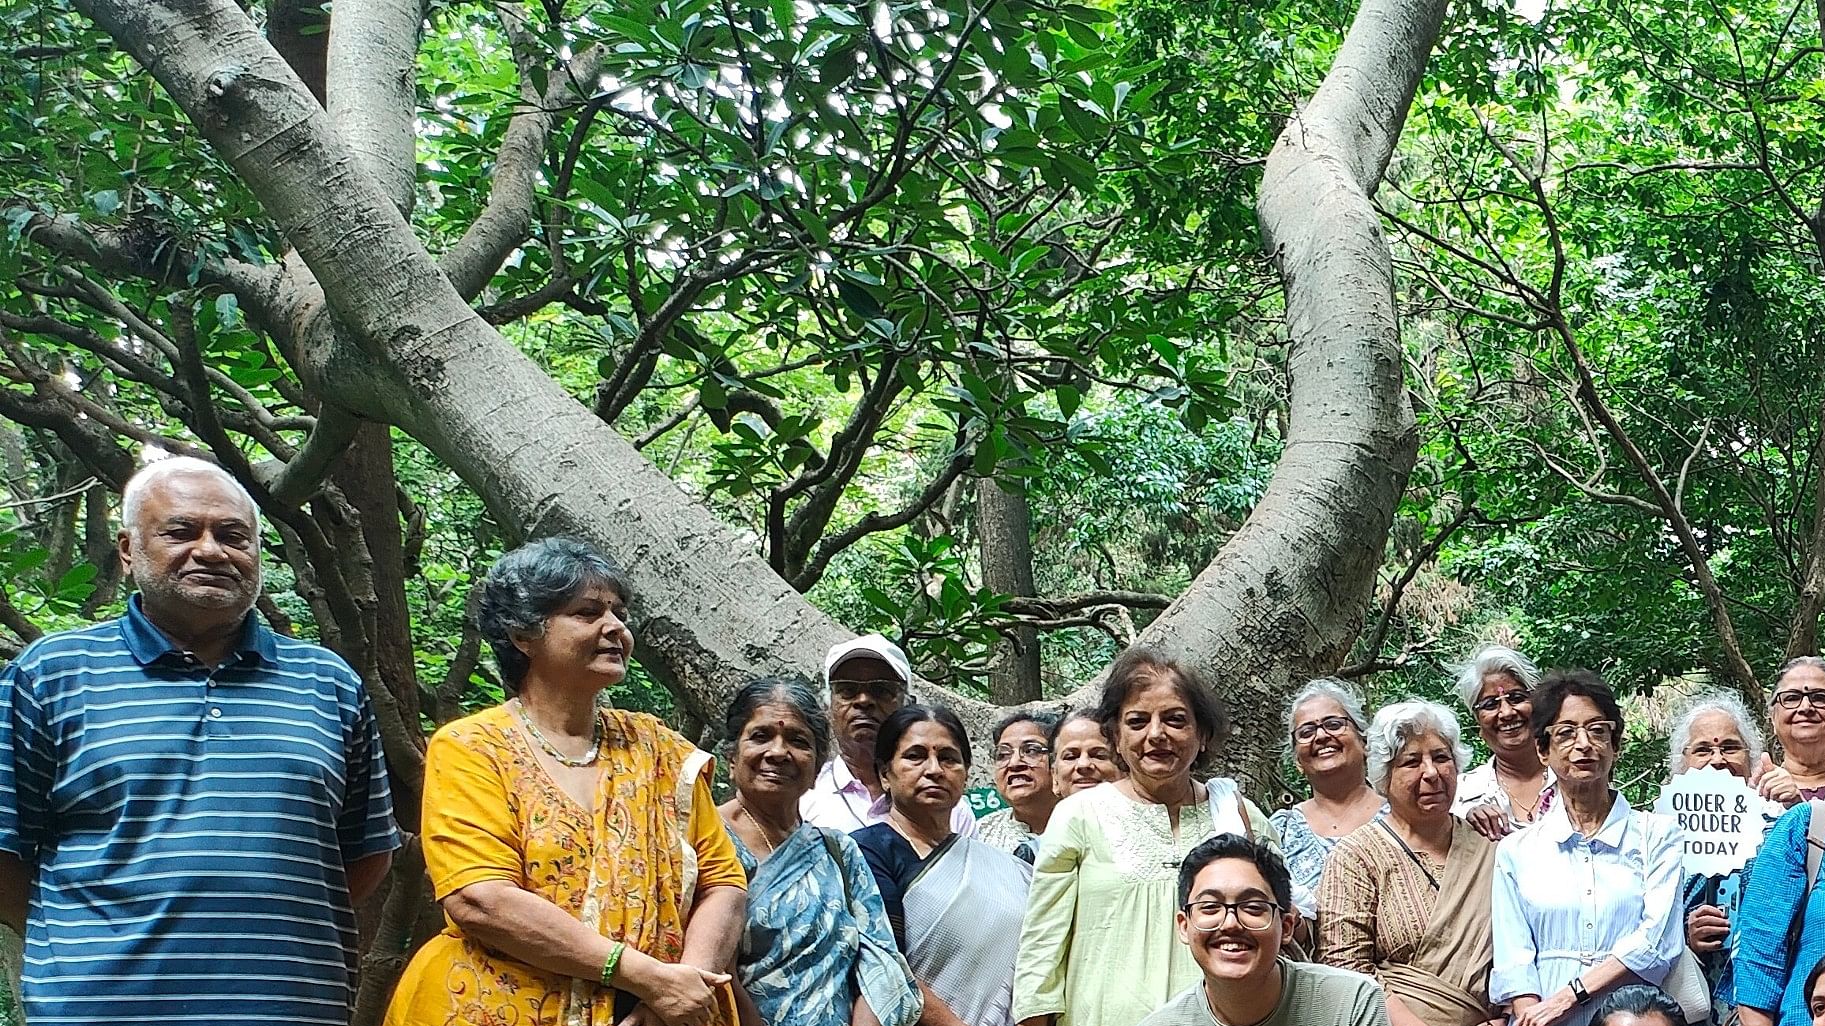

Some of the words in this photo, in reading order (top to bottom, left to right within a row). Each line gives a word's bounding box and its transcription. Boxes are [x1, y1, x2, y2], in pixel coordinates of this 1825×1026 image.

[1672, 792, 1725, 812] OLDER
[1734, 794, 1748, 813] &
[1677, 812, 1741, 833] BOLDER
[1683, 840, 1739, 856] TODAY
